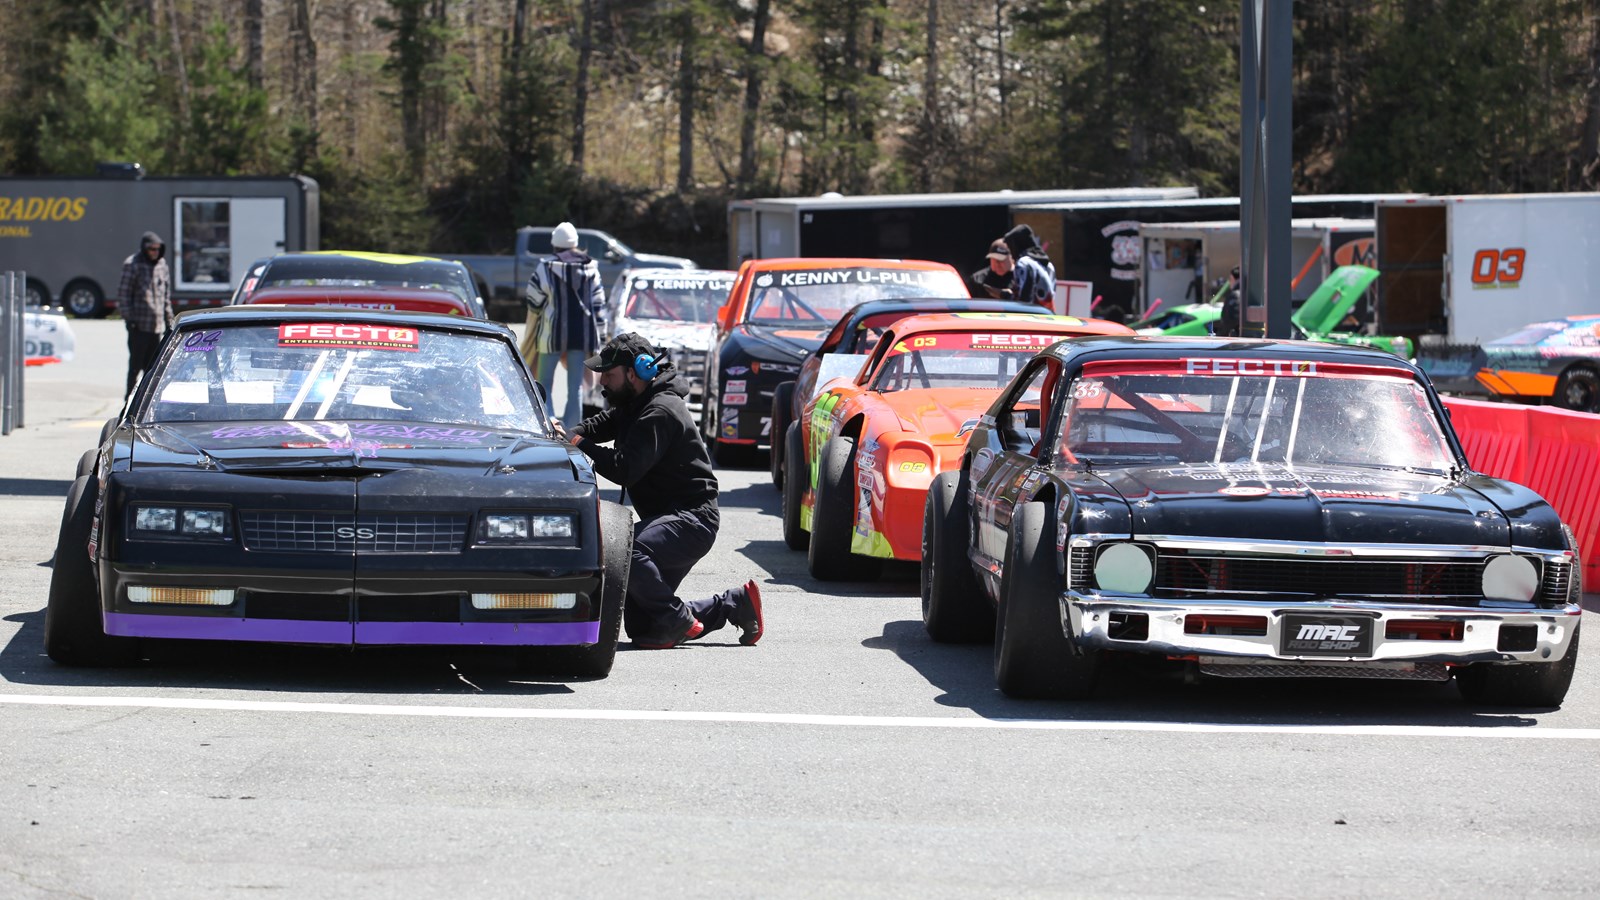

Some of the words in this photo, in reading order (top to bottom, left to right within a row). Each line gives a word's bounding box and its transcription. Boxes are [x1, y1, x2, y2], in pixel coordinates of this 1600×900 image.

[0, 197, 88, 221] RADIOS
[1471, 248, 1526, 284] 03
[653, 280, 705, 290] KENNY
[781, 270, 852, 286] KENNY
[185, 330, 223, 348] 04
[284, 325, 414, 342] FECTO
[913, 337, 937, 347] 03
[1186, 358, 1317, 376] FECTO
[1074, 381, 1104, 400] 35
[337, 527, 375, 539] SS
[1296, 624, 1361, 641] MAC
[1318, 641, 1361, 650] SHOP
